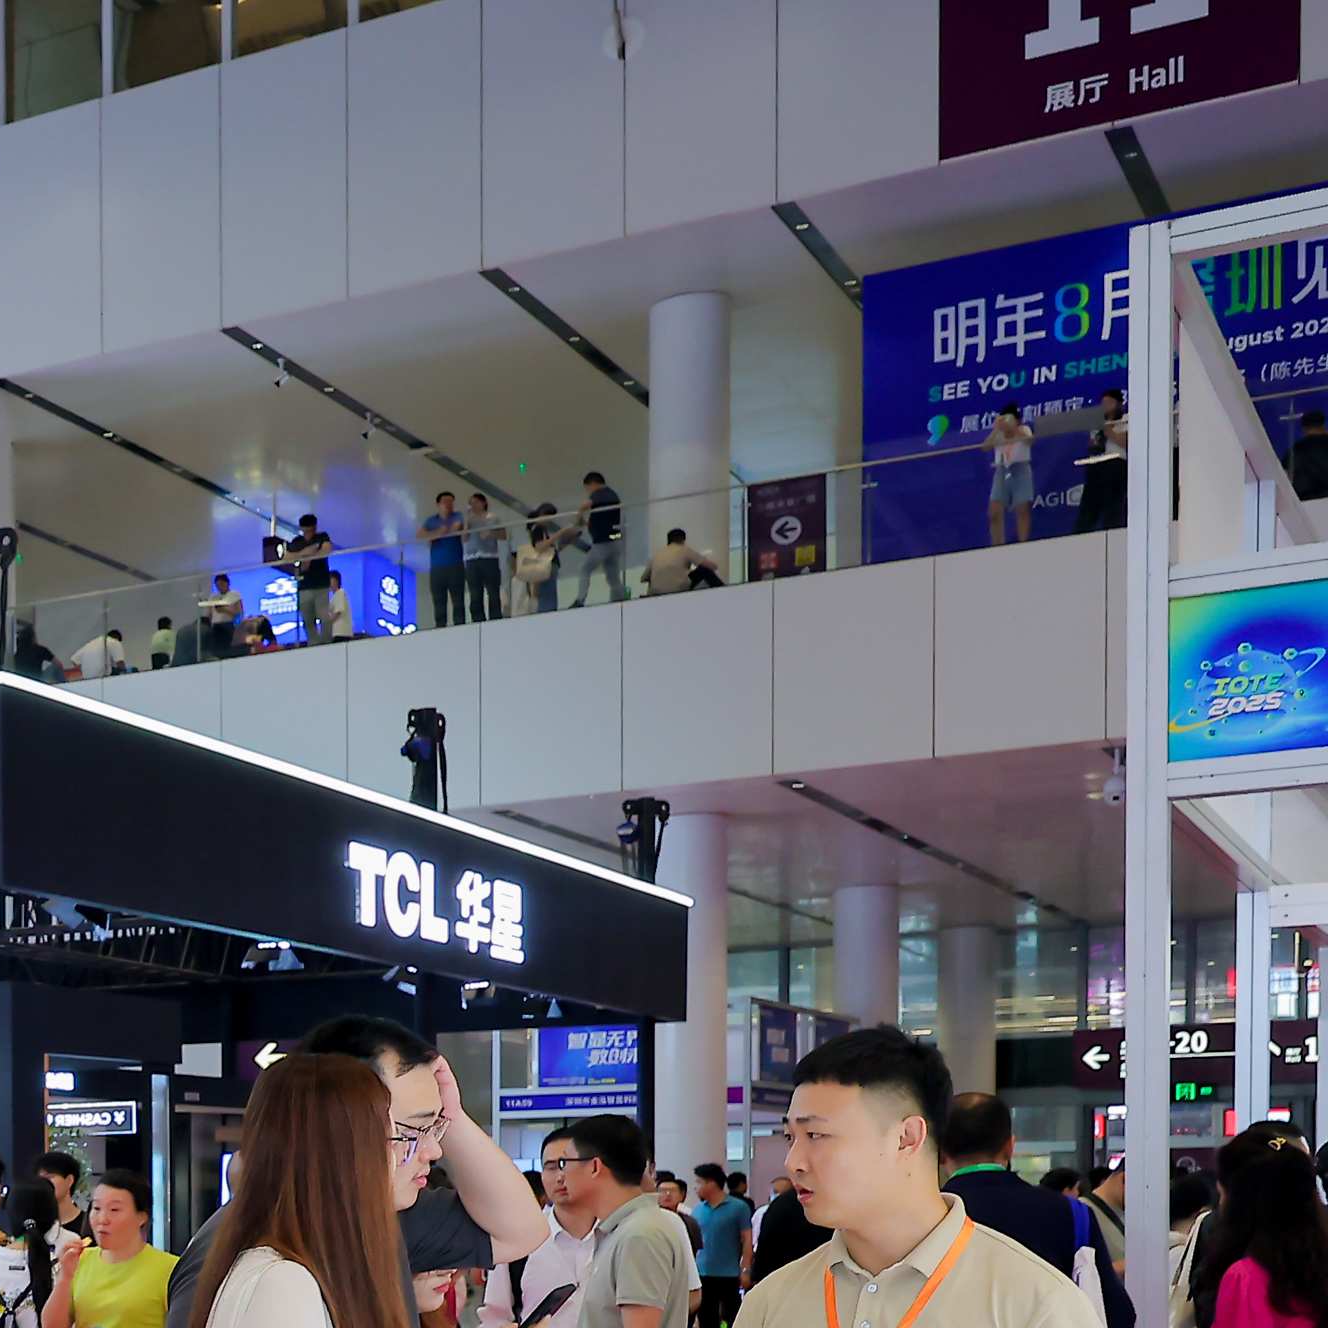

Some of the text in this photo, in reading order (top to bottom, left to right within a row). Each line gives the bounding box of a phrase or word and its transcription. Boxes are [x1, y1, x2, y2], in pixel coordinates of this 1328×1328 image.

[1044, 55, 1185, 114] 展厅 Hall
[929, 380, 970, 402] SEE
[977, 370, 1026, 394] YOU
[1033, 364, 1057, 385] IN
[1064, 351, 1129, 378] SHEN
[1226, 325, 1285, 352] ugust
[1208, 691, 1286, 716] 2025
[1210, 672, 1285, 697] IOTE
[348, 840, 526, 965] TCL 华星
